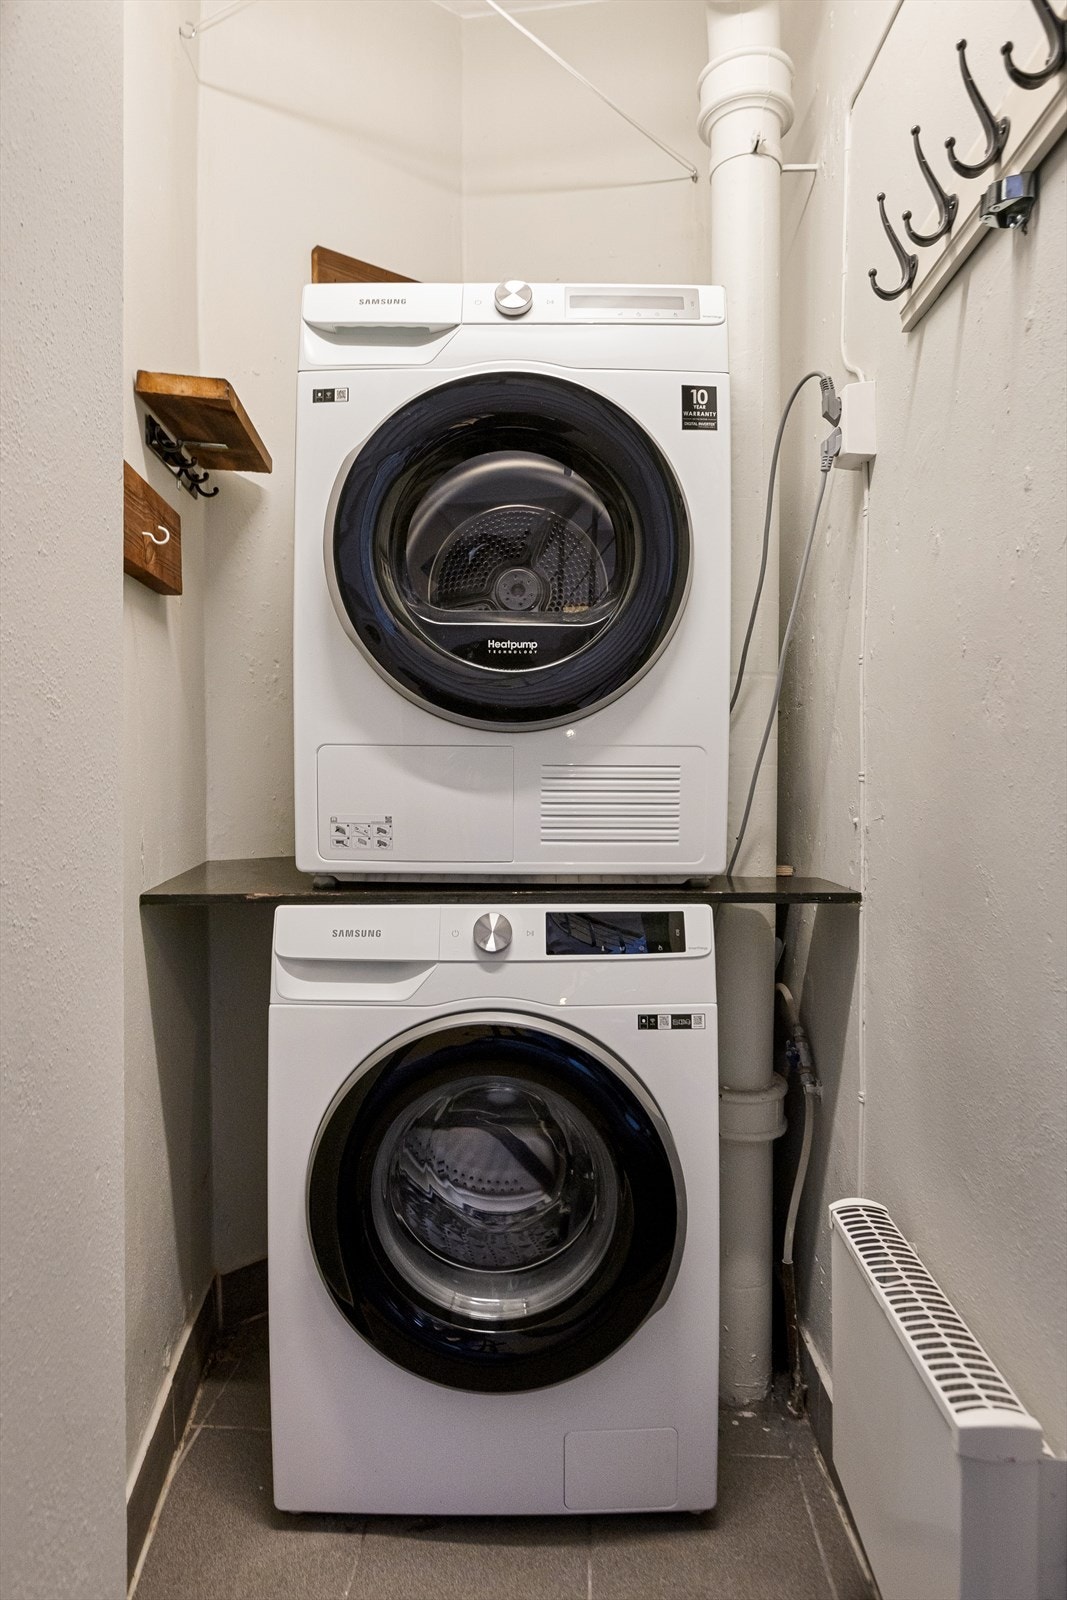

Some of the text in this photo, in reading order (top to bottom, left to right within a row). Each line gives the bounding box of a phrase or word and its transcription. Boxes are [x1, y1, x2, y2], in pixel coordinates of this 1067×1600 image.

[690, 389, 708, 404] 10
[487, 640, 538, 650] Heatpump
[332, 929, 381, 938] SAMSUNG
